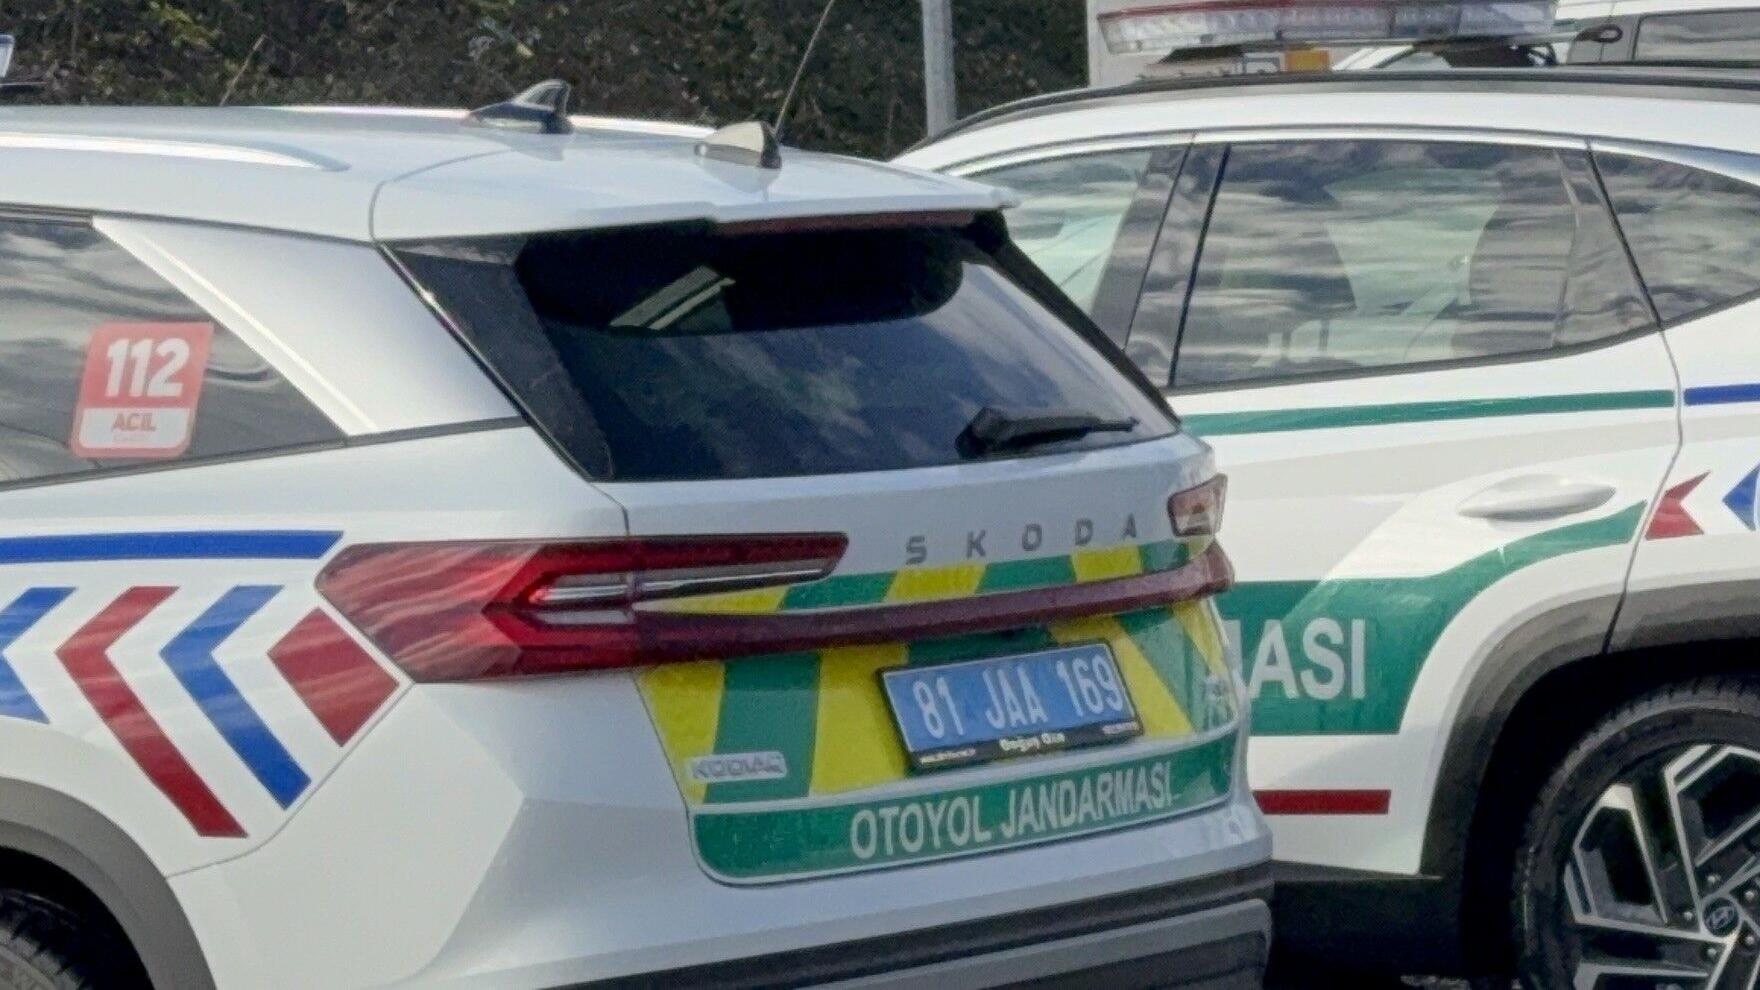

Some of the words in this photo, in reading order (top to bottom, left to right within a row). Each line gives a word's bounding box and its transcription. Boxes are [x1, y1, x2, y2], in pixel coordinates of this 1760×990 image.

[105, 337, 190, 397] 112
[912, 677, 964, 739] 81
[982, 665, 1049, 729] JAA
[1056, 655, 1123, 717] 169
[851, 790, 990, 859] OTOYOL
[1001, 761, 1172, 835] JANDARMASI
